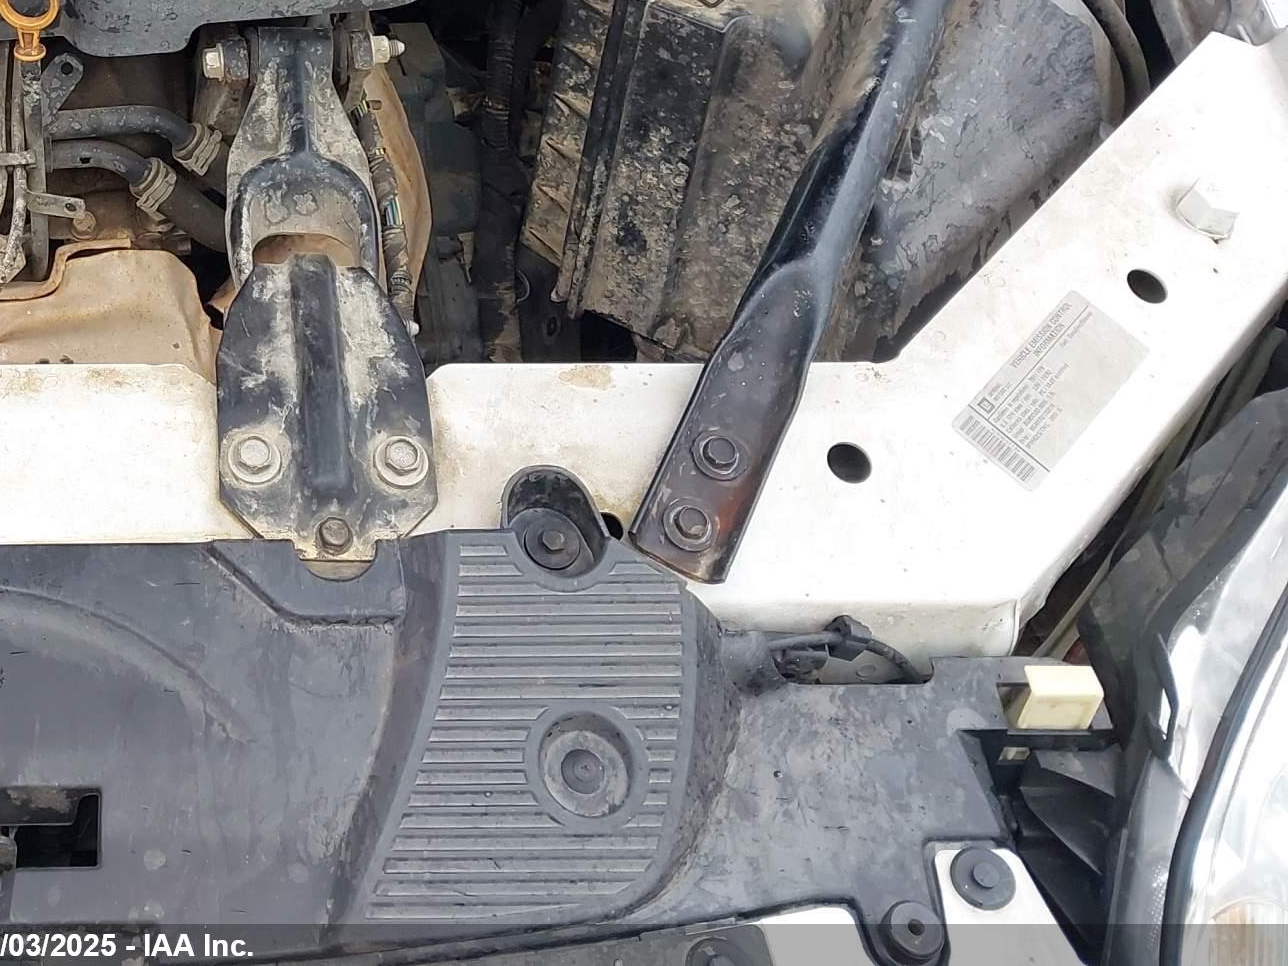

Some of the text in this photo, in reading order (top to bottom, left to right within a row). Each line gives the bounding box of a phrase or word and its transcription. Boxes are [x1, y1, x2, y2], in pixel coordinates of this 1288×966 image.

[1010, 347, 1032, 369] VEHICLE
[1030, 324, 1052, 349] EMISSION
[1049, 302, 1072, 326] CONTROL
[1032, 323, 1066, 357] INFORMATION
